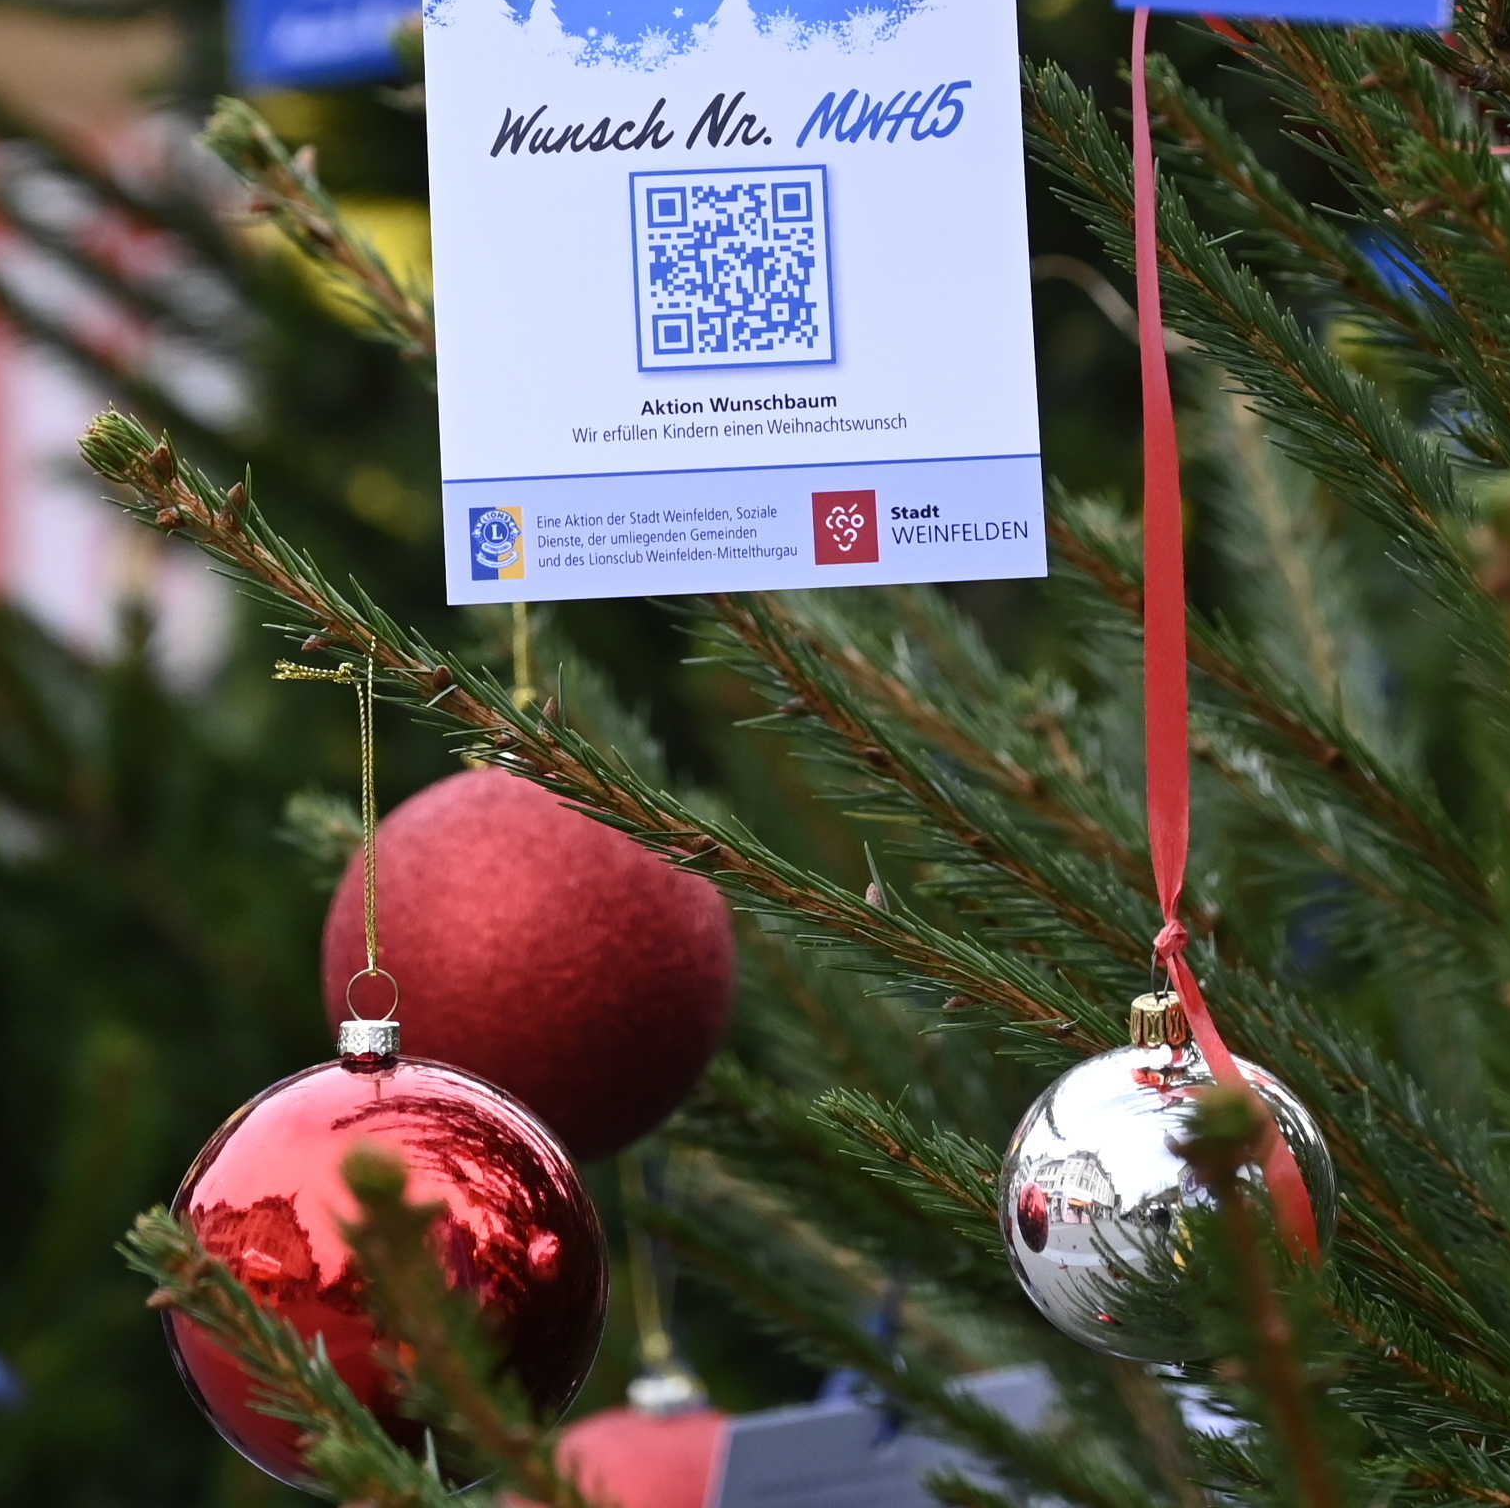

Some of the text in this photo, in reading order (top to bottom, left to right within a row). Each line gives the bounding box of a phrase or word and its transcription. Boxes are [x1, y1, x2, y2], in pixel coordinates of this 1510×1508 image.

[490, 80, 972, 158] Wunsch Nr. MWH5
[640, 393, 837, 416] Aktion Wunschbaum
[572, 413, 907, 443] Wir erfüllen Kindern einen Weihnachtswunsch
[536, 505, 777, 529] Eine Aktion der Stadt Weinfelden, Soziale
[891, 504, 940, 520] Stadt
[491, 523, 504, 540] L
[537, 525, 757, 549] Dienste, der umliegenden Gemeinden
[891, 520, 1028, 544] WEINFELDEN
[538, 553, 561, 568] und
[564, 551, 585, 567] des
[589, 548, 644, 566] Lionsclub
[645, 544, 798, 564] Weinfelden-Mittelthurgau
